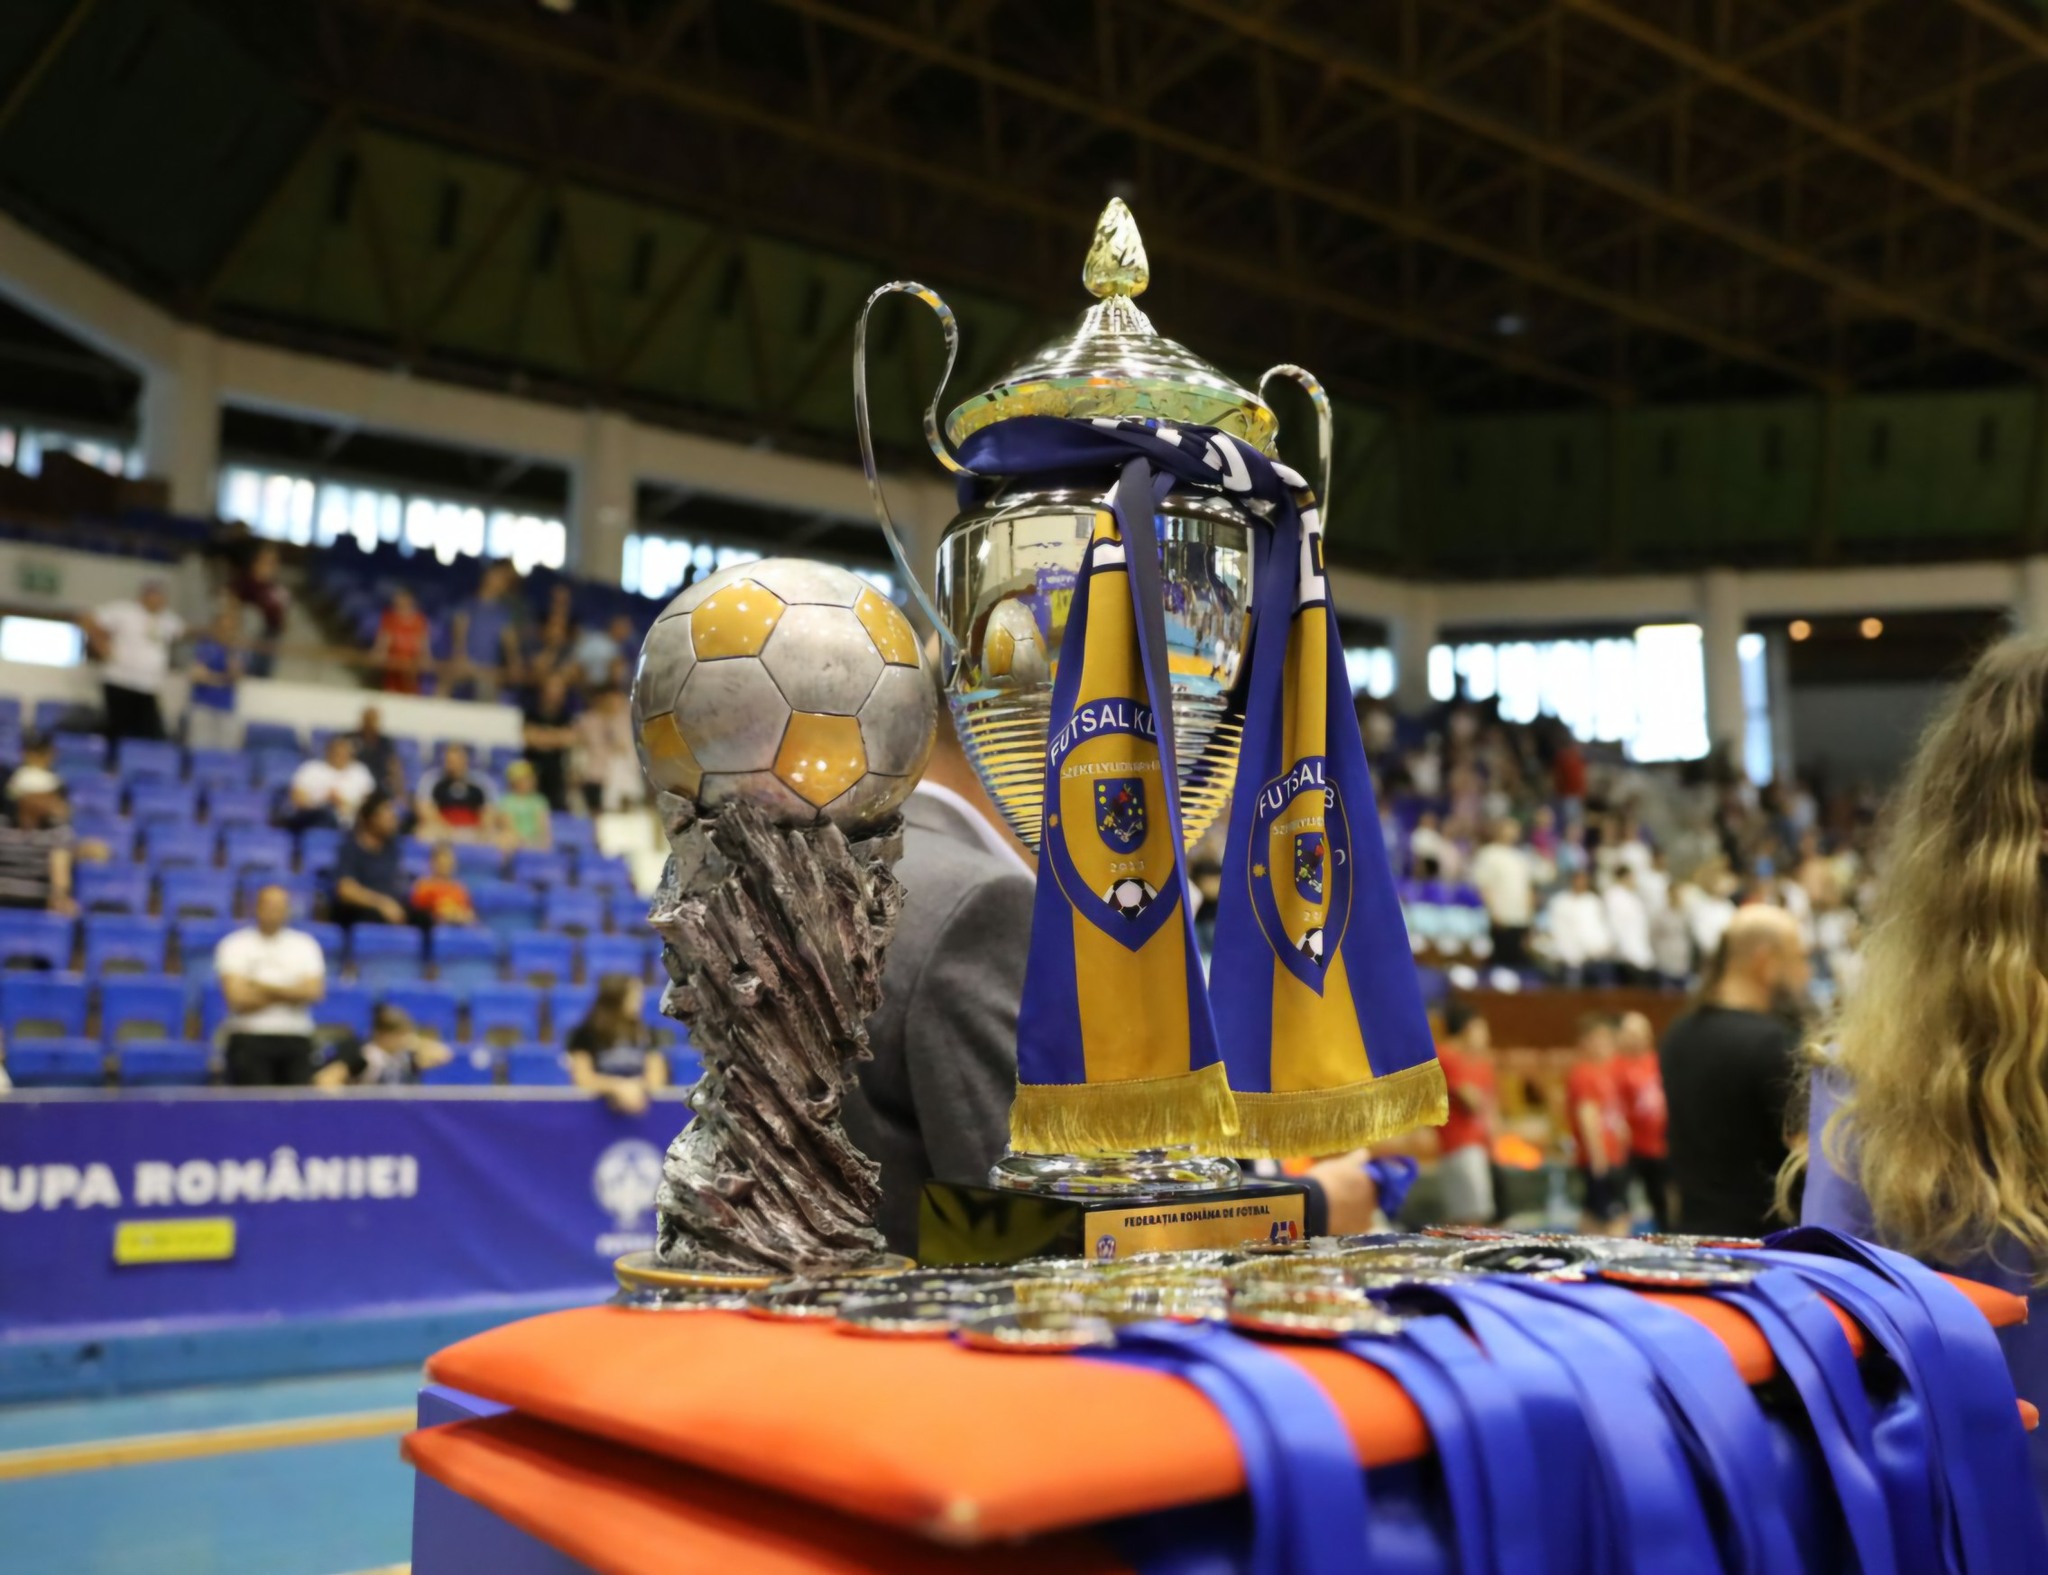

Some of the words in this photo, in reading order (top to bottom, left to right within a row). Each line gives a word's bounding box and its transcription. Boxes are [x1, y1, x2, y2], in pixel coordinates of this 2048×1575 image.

[1050, 703, 1130, 767] FUTSAL
[1259, 761, 1326, 819] FUTSAL
[133, 1145, 418, 1207] ROMÂNIEI
[1223, 1207, 1234, 1218] DE
[1236, 1205, 1270, 1217] FOTBAL
